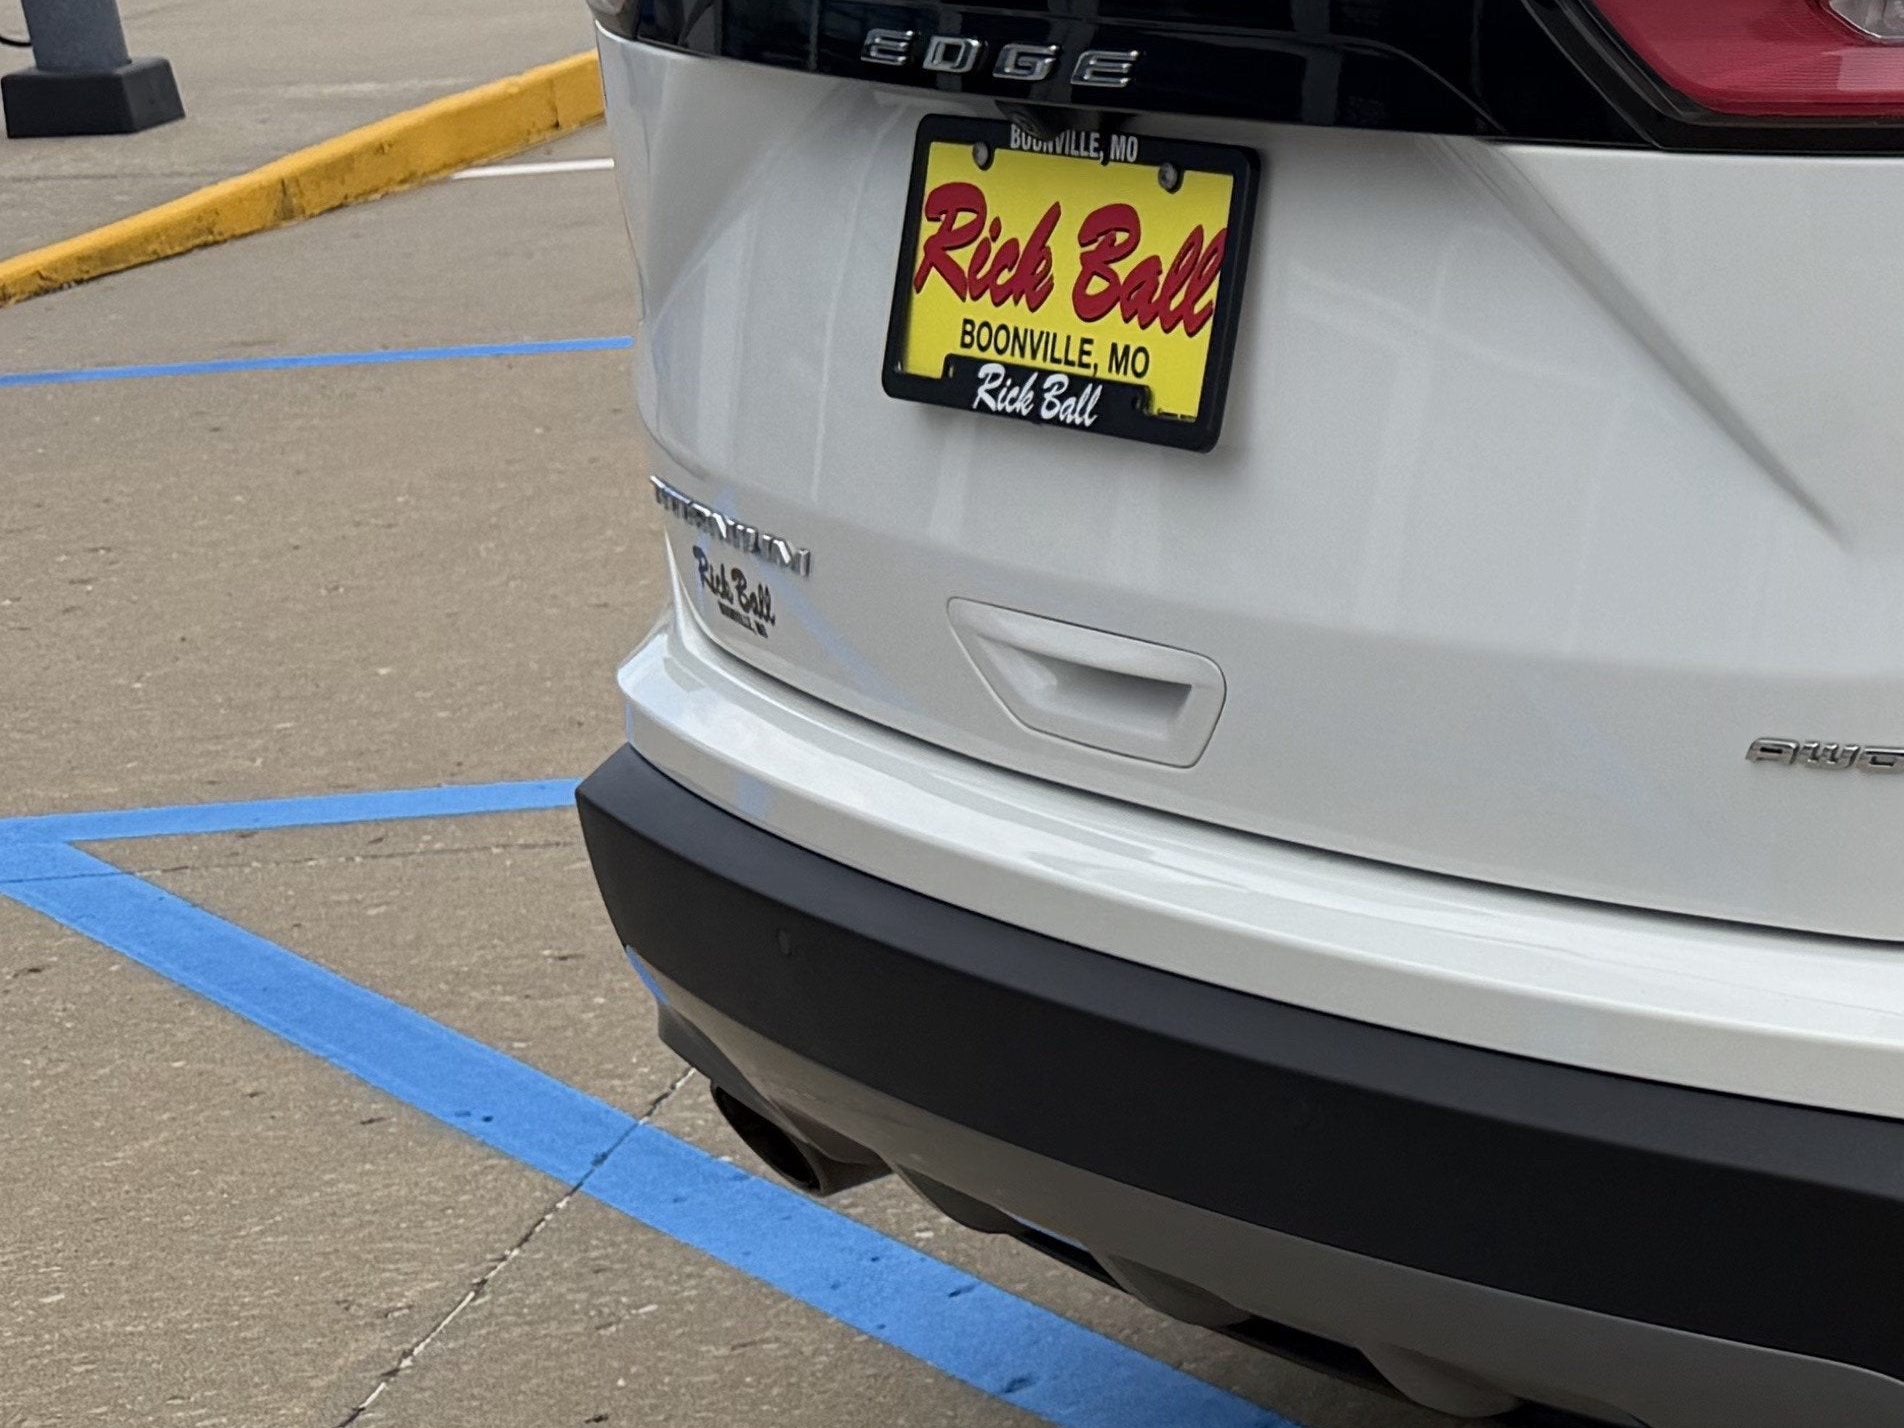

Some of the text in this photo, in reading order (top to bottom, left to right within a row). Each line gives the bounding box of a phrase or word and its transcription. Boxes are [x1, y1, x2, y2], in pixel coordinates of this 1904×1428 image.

[860, 27, 1145, 88] EDGE
[1109, 134, 1139, 163] MO
[914, 181, 1230, 337] Rick Ball
[959, 318, 1150, 379] BOONVILLE, MO
[972, 362, 1103, 428] Rick Ball
